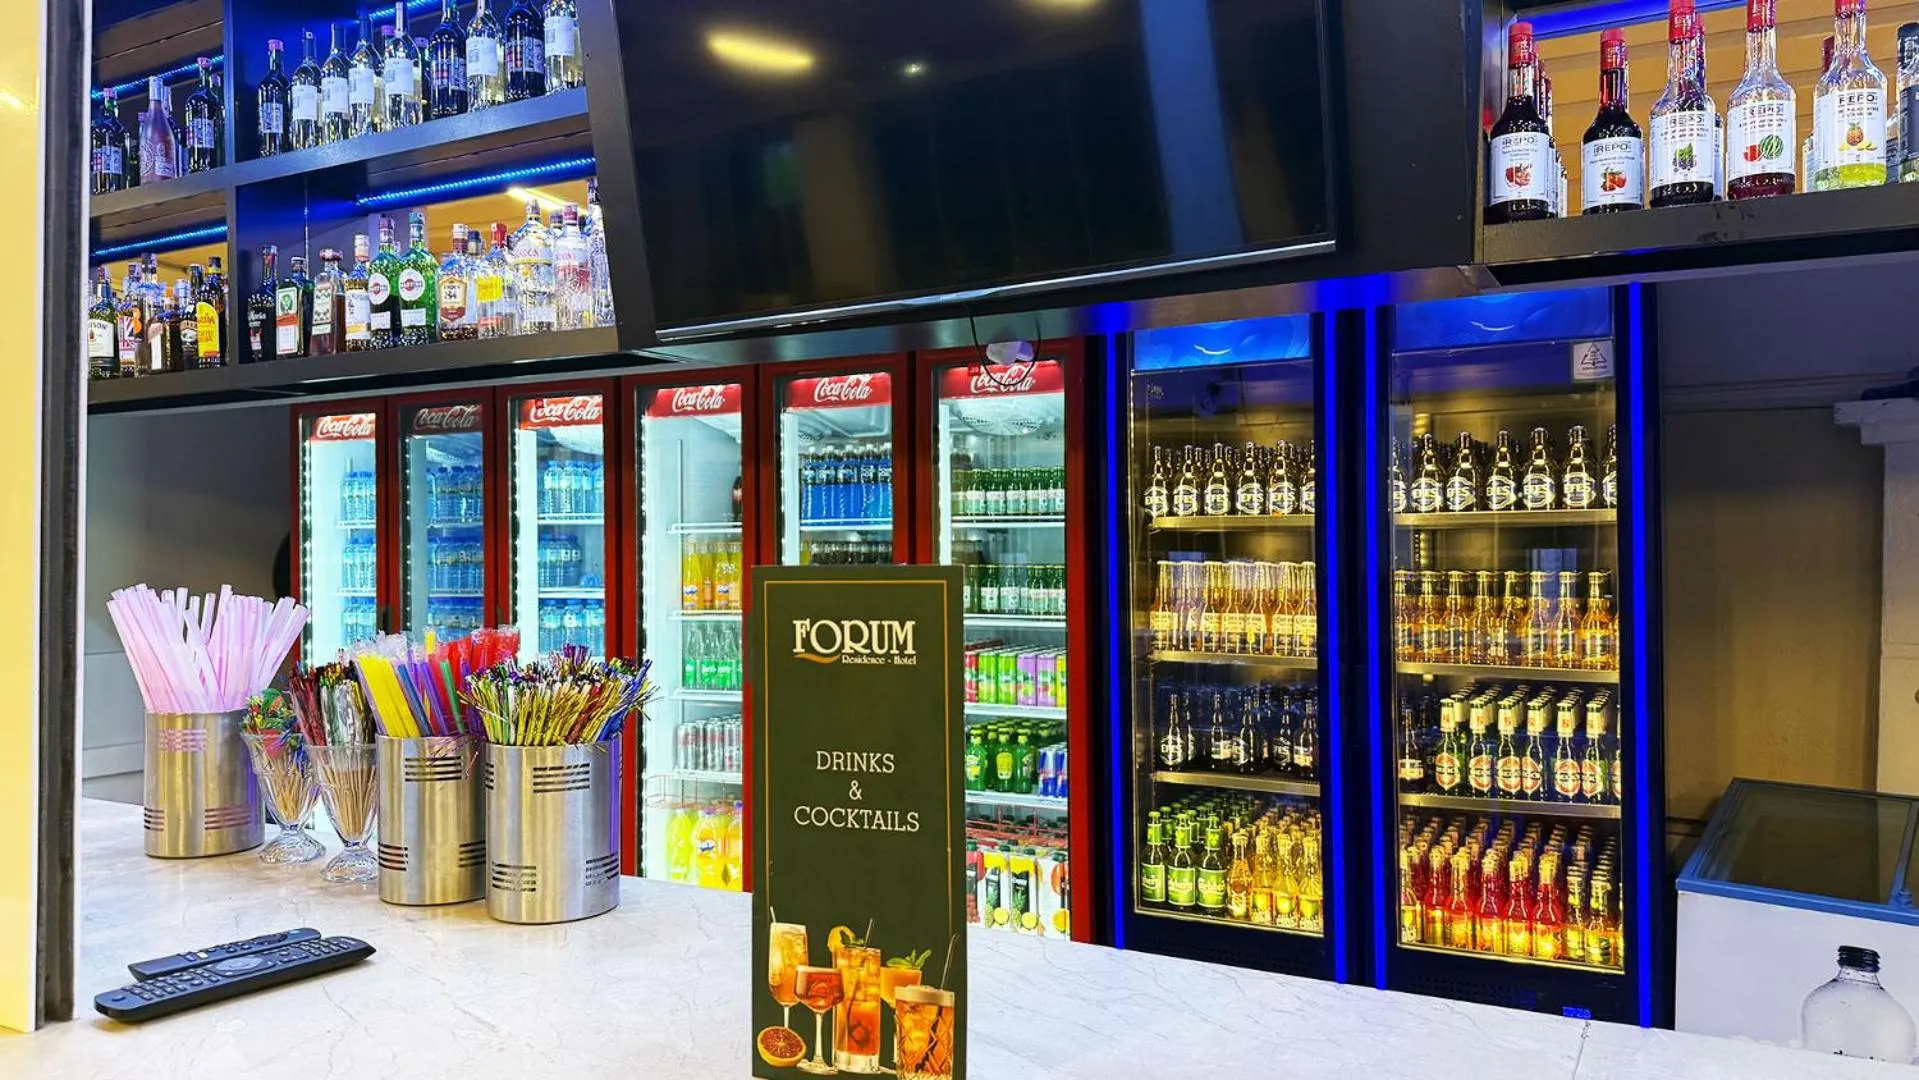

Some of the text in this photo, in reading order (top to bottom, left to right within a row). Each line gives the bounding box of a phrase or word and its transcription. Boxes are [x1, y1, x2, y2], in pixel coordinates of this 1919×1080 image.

[1506, 136, 1535, 146] REPO
[1597, 143, 1628, 153] REPO
[672, 385, 725, 413] Coca-Cola
[814, 374, 872, 403] Coca-Cola
[413, 404, 481, 430] Coca-Cola
[529, 395, 603, 423] Coca-Cola
[316, 413, 376, 439] Coca-Cola
[792, 618, 916, 655] FORUM
[841, 654, 885, 665] Residence
[893, 655, 917, 665] Hotel
[816, 750, 895, 774] DRINKS
[848, 779, 862, 800] &
[793, 805, 920, 832] COCKTAILS
